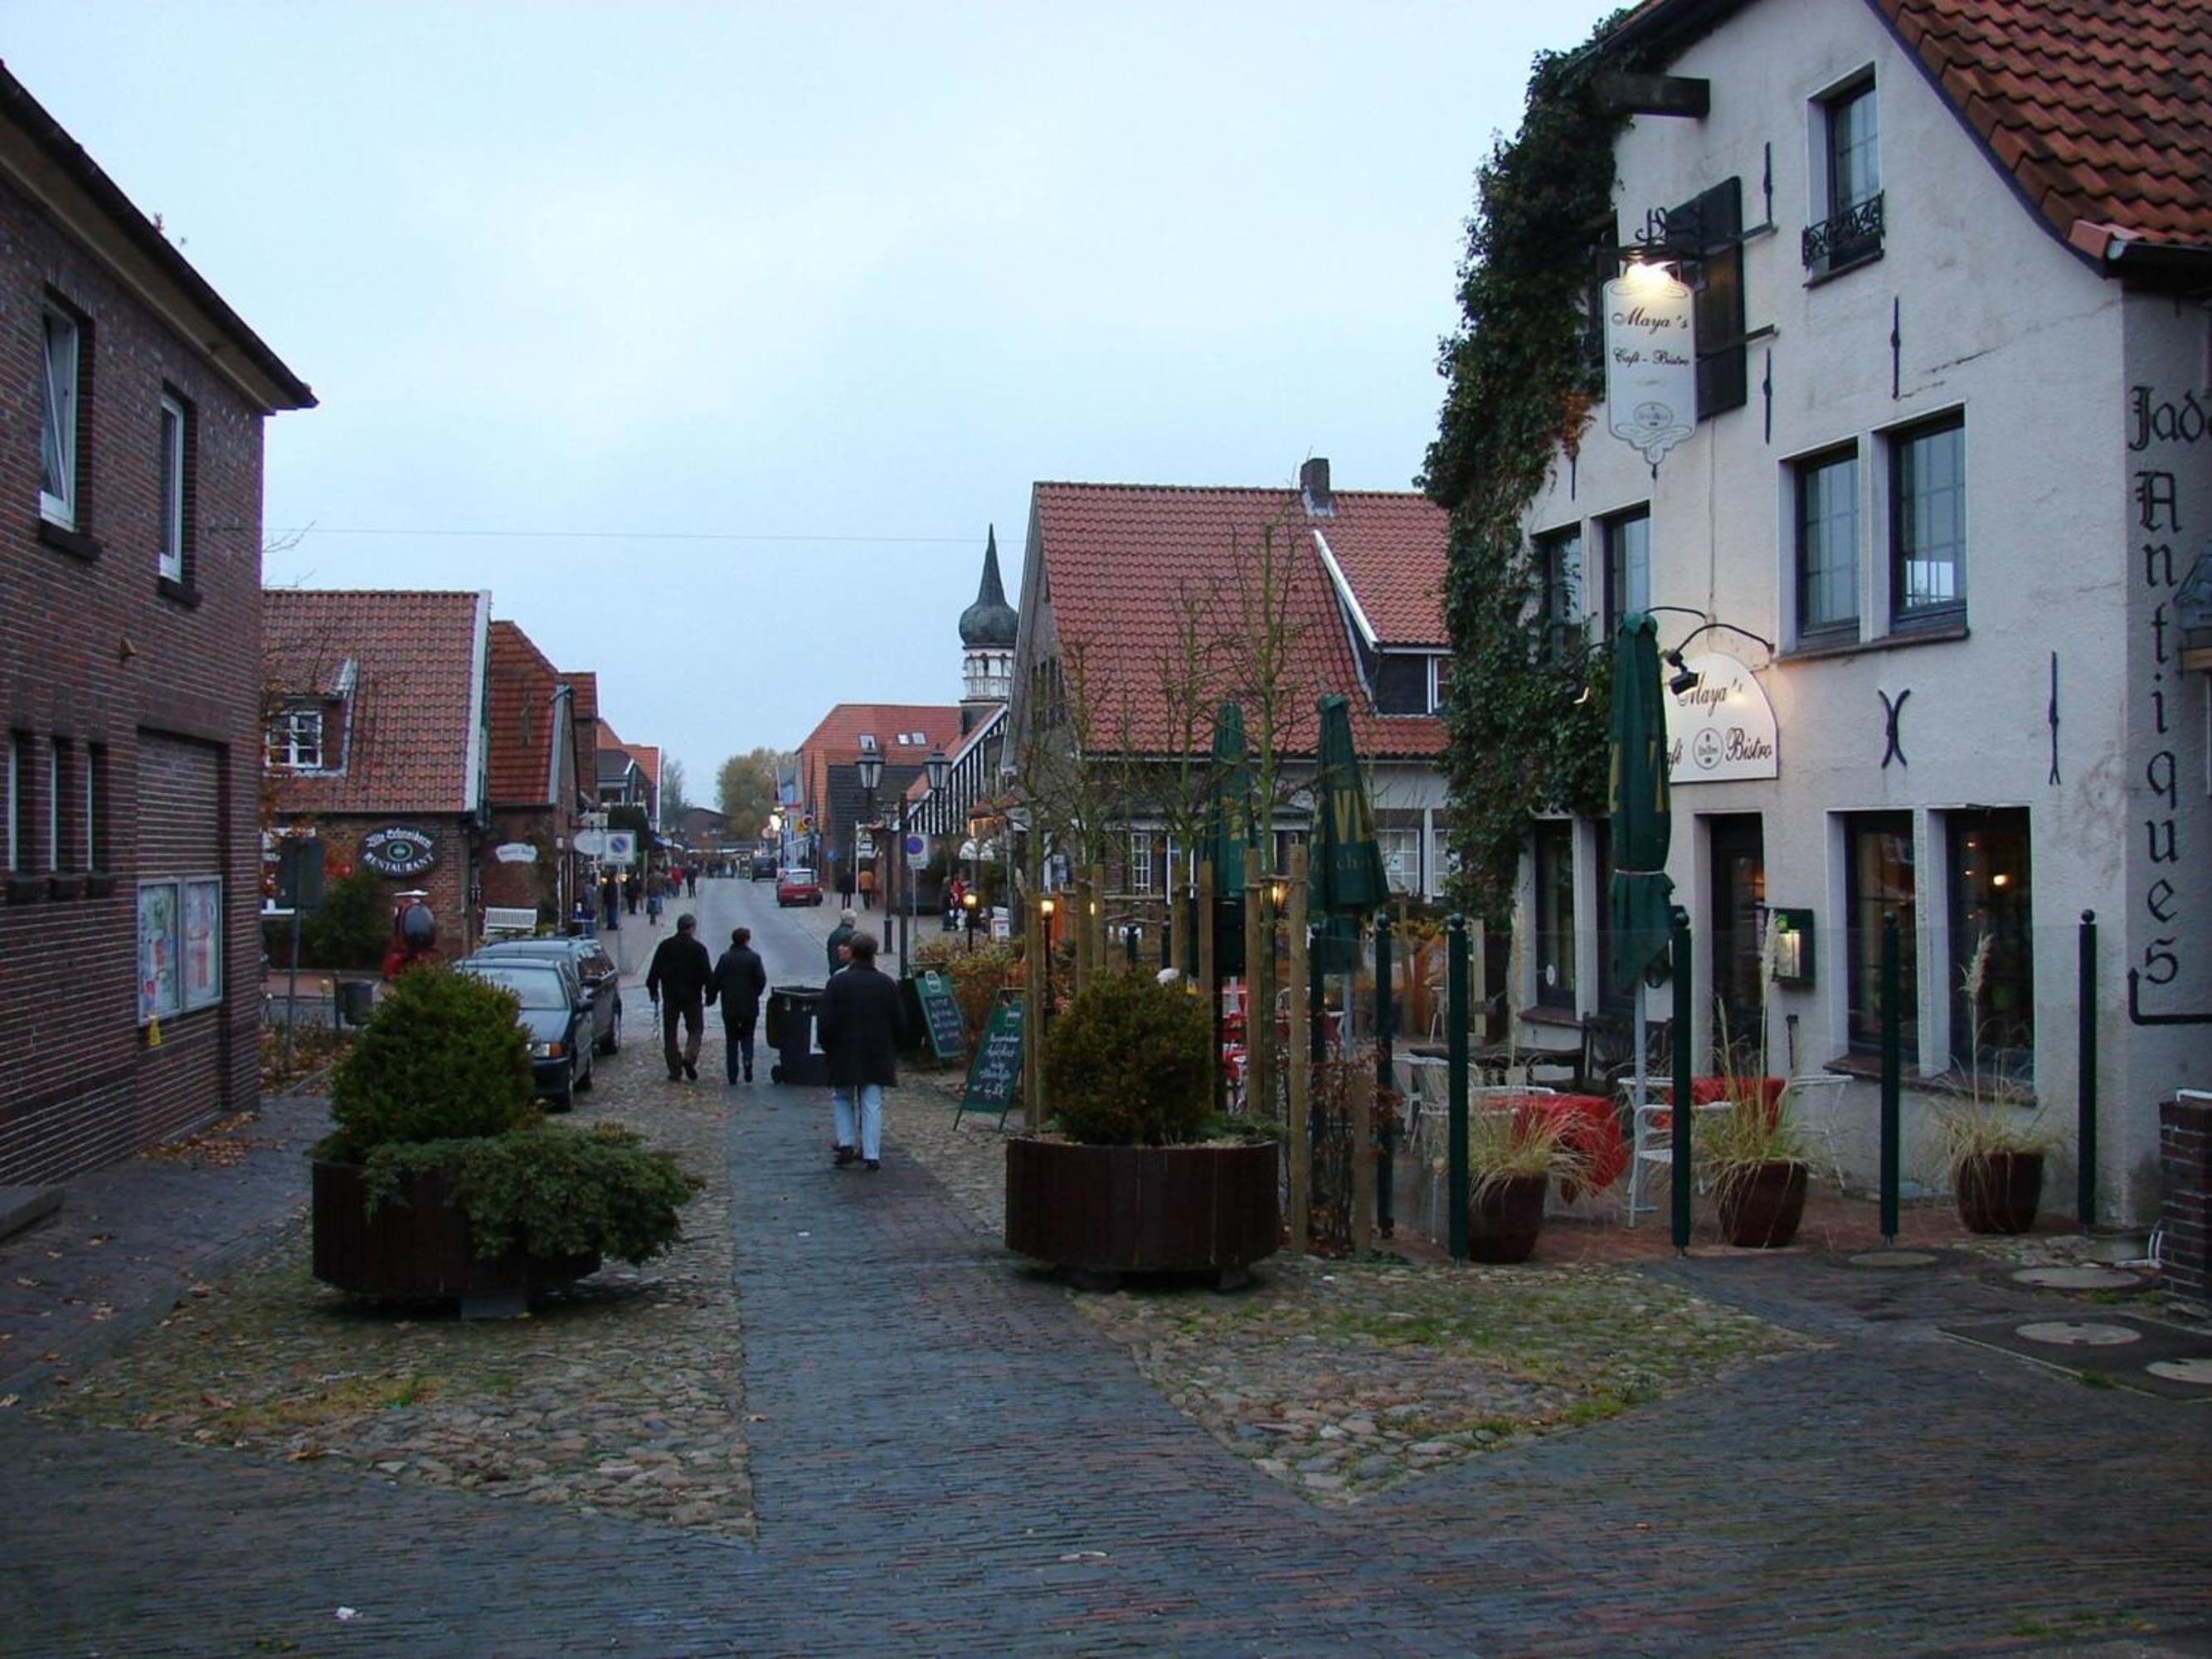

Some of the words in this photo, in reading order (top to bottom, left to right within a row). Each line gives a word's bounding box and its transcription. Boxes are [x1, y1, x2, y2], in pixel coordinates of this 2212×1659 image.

[1651, 348, 1689, 367] Bistro
[2127, 385, 2212, 451] Jad
[1725, 727, 1772, 761] Bistro
[2134, 470, 2184, 985] Antiques
[363, 852, 434, 873] RESTAURANT
